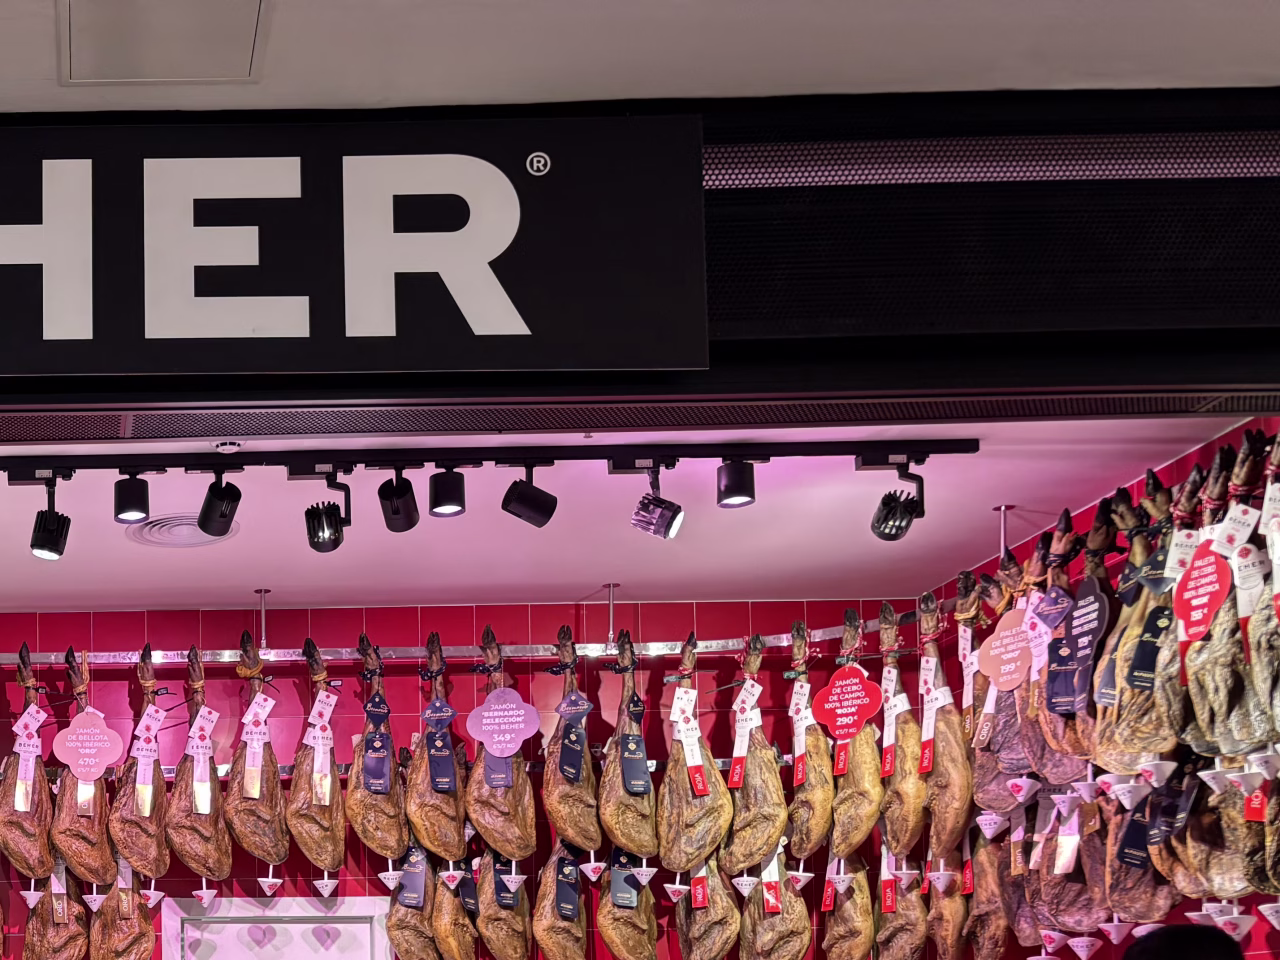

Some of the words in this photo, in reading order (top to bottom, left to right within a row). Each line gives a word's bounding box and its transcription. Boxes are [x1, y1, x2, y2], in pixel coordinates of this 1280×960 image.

[992, 640, 1002, 648] DE
[834, 678, 860, 687] JAMÓN
[842, 685, 862, 693] CEBO
[840, 692, 865, 700] CAMPO
[841, 698, 870, 707] IBÉRICO
[980, 722, 992, 740] ORO
[82, 740, 111, 748] IBÉRICO
[838, 751, 846, 769] ROJA
[922, 748, 930, 767] ROJA
[694, 772, 704, 790] ROJA
[696, 884, 704, 902] ROJA
